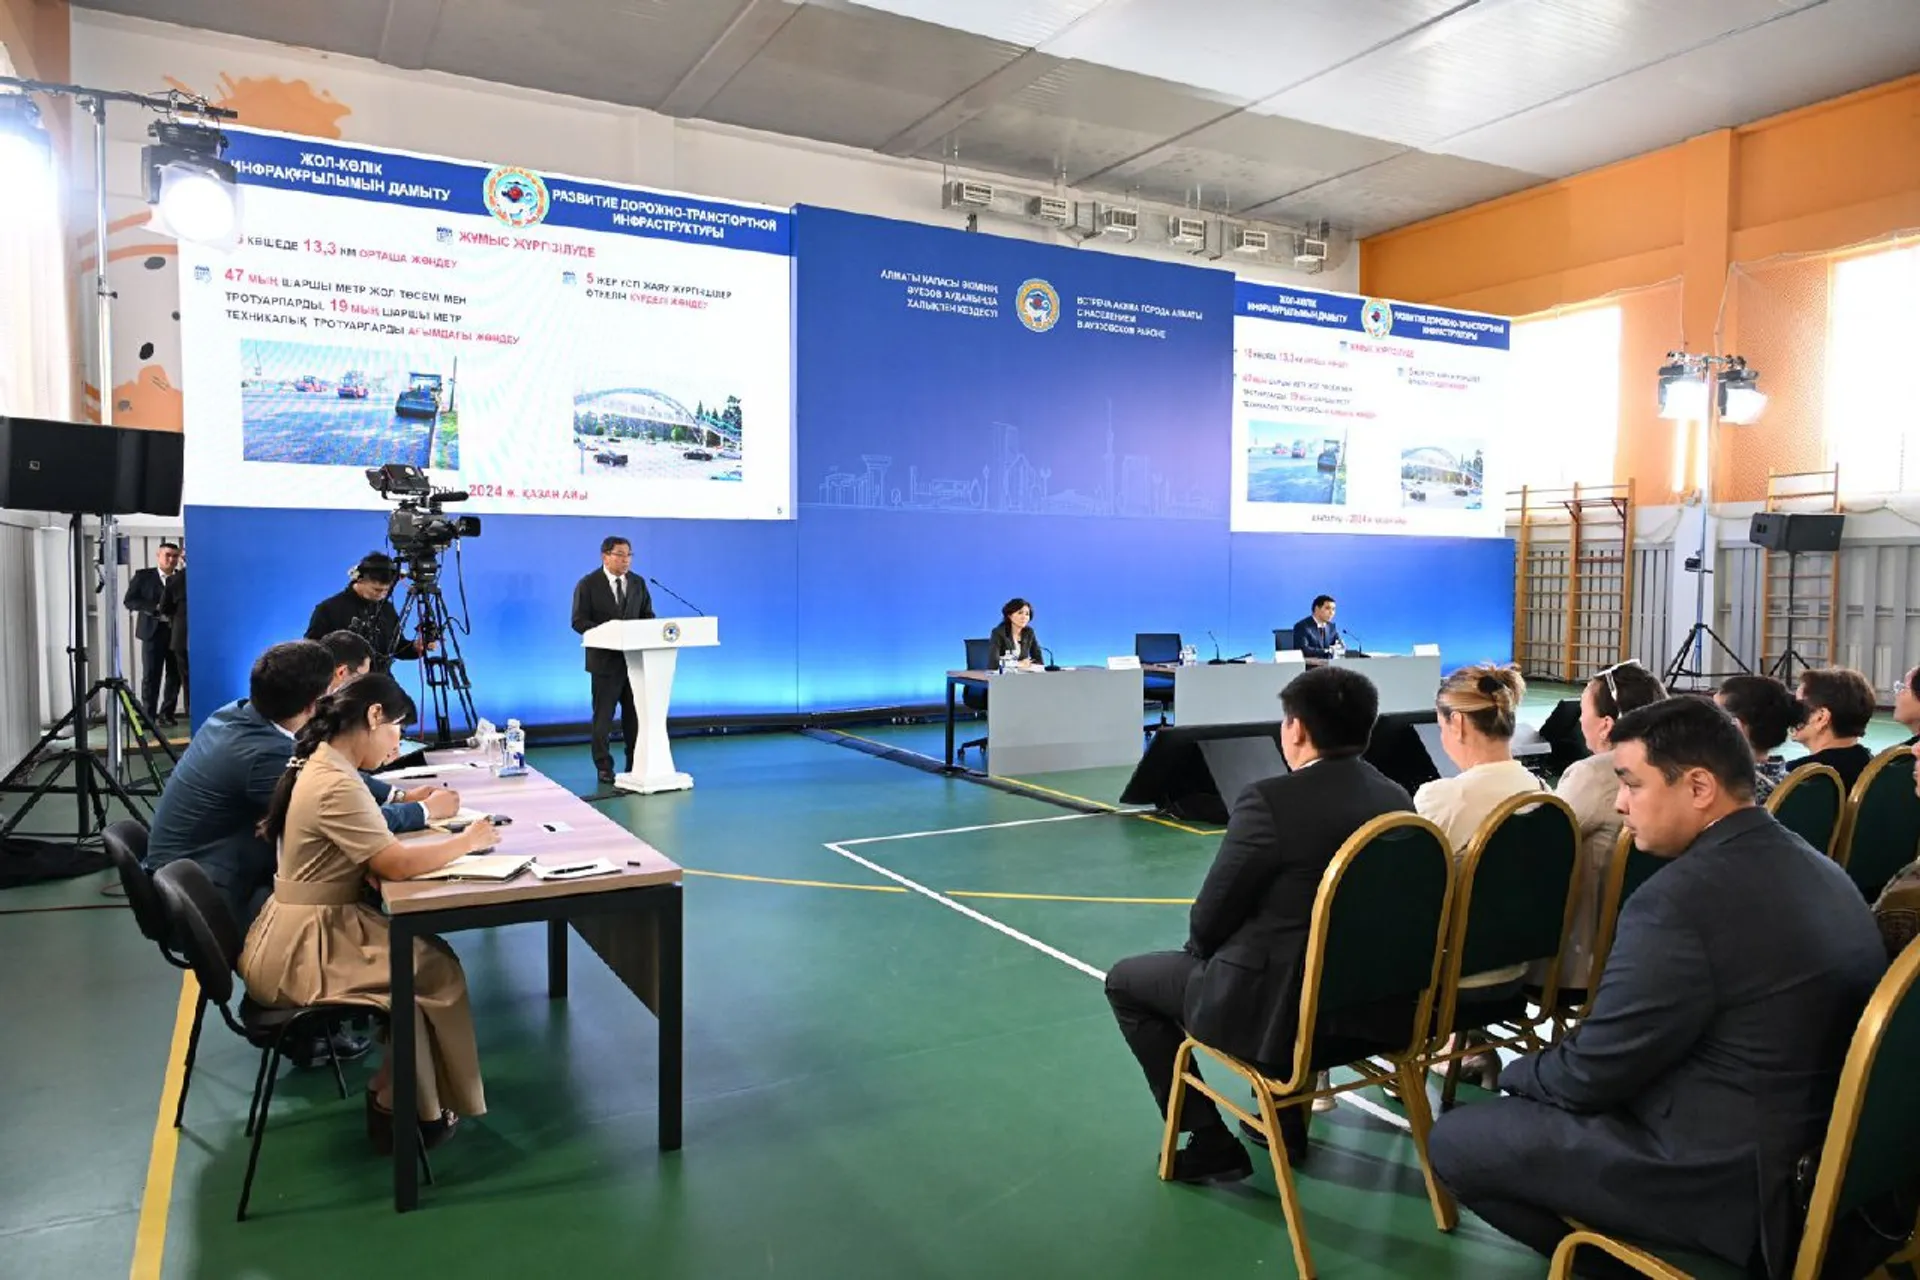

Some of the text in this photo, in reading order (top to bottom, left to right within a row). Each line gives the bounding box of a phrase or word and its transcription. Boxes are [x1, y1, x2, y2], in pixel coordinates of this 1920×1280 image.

[300, 152, 383, 175] ЖОЛ-КӨЛІК
[388, 182, 451, 201] ДАМЫТУ
[552, 189, 777, 232] РАЗВИТИЕ ДОРОЖНО-ТРАНСПОРТНОЙ
[613, 213, 724, 238] ИНФРАСТРУКТУРЫ
[303, 239, 337, 256] 13,3
[359, 249, 408, 263] ОРТАША
[224, 268, 244, 281] 47
[282, 278, 332, 292] ШАРШЫ
[335, 283, 367, 294] МЕТР
[369, 287, 394, 298] ЖОЛ
[443, 295, 467, 305] МЕН
[586, 272, 594, 284] 5
[880, 269, 921, 282] АЛМАТЫ
[330, 299, 348, 312] 19
[433, 312, 462, 323] МЕТР
[1141, 304, 1171, 317] ГОРОДА
[468, 484, 503, 498] 2024
[522, 488, 560, 500] ҚАЗАН
